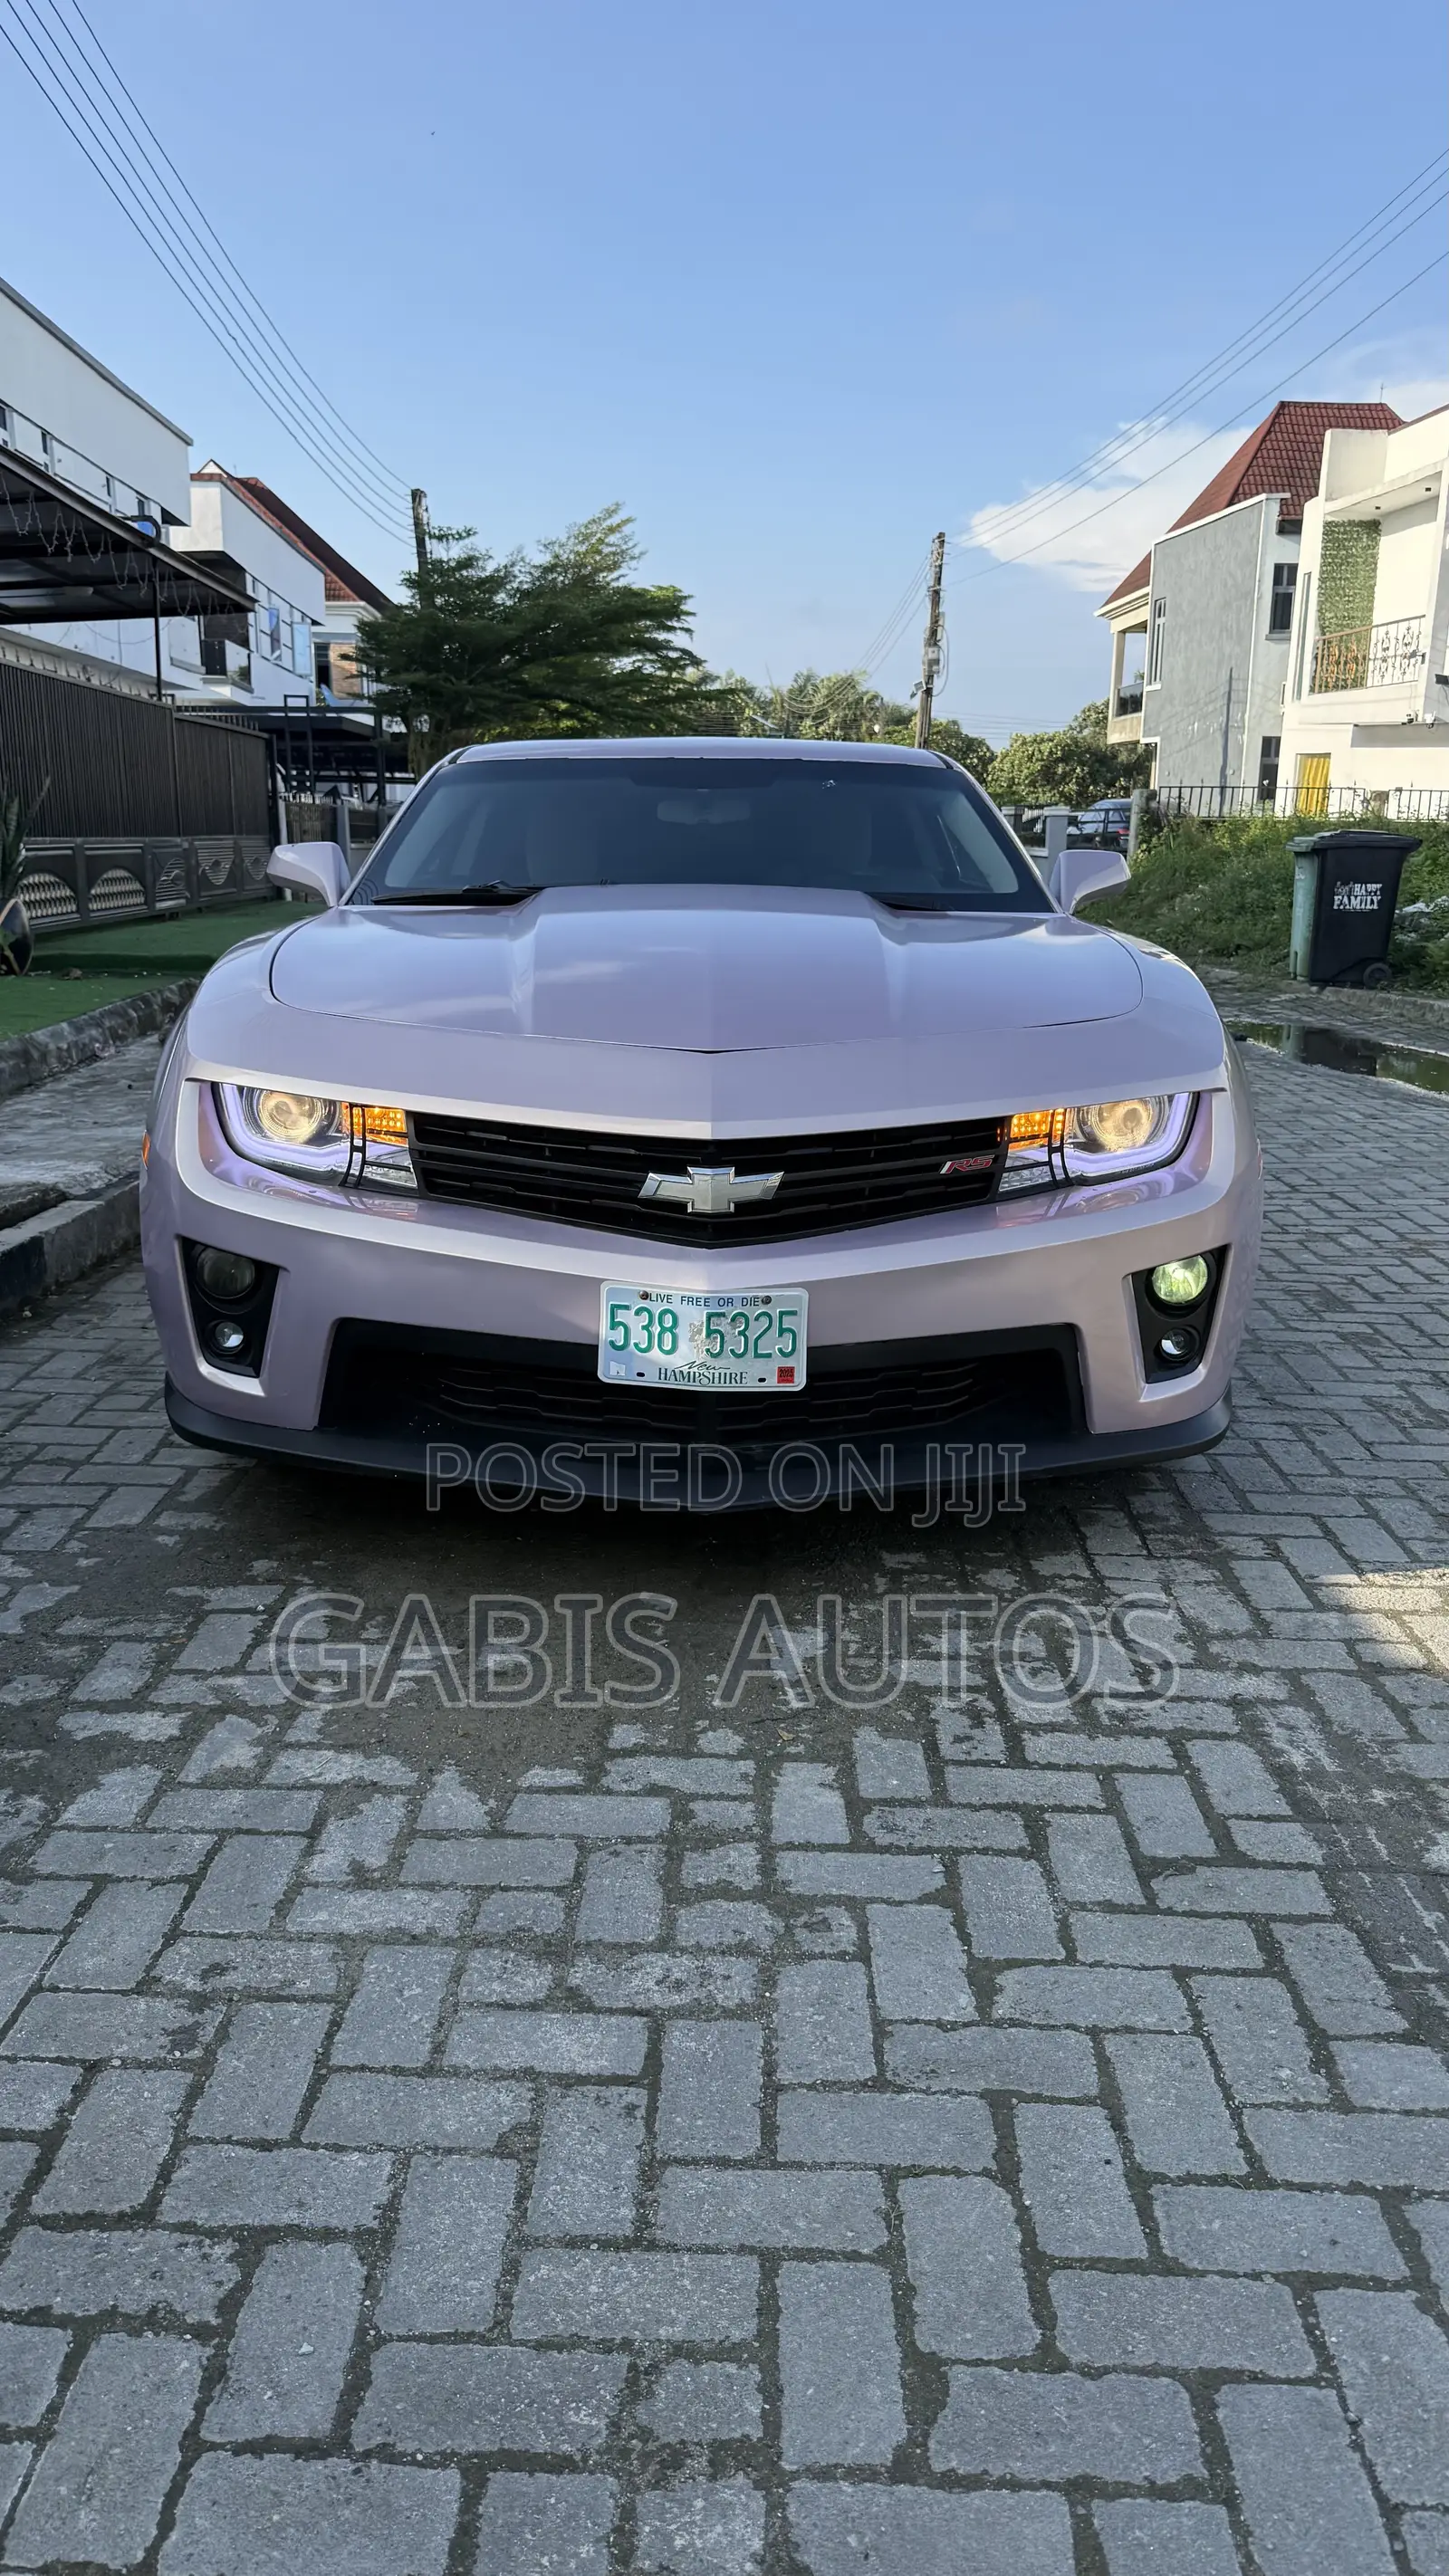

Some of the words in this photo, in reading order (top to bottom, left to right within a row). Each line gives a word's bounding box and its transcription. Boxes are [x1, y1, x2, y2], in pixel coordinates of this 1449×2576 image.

[1354, 884, 1382, 895] HAPPY
[1333, 895, 1382, 909] FAMILY
[943, 1154, 995, 1173] RS
[649, 1294, 673, 1304] LIVE
[680, 1296, 711, 1307] FREE
[717, 1298, 734, 1307] OR
[741, 1297, 760, 1307] DIE
[609, 1302, 678, 1355] 538
[704, 1309, 799, 1359] 5325
[674, 1360, 731, 1371] New
[657, 1367, 748, 1385] HAMPSHIRE
